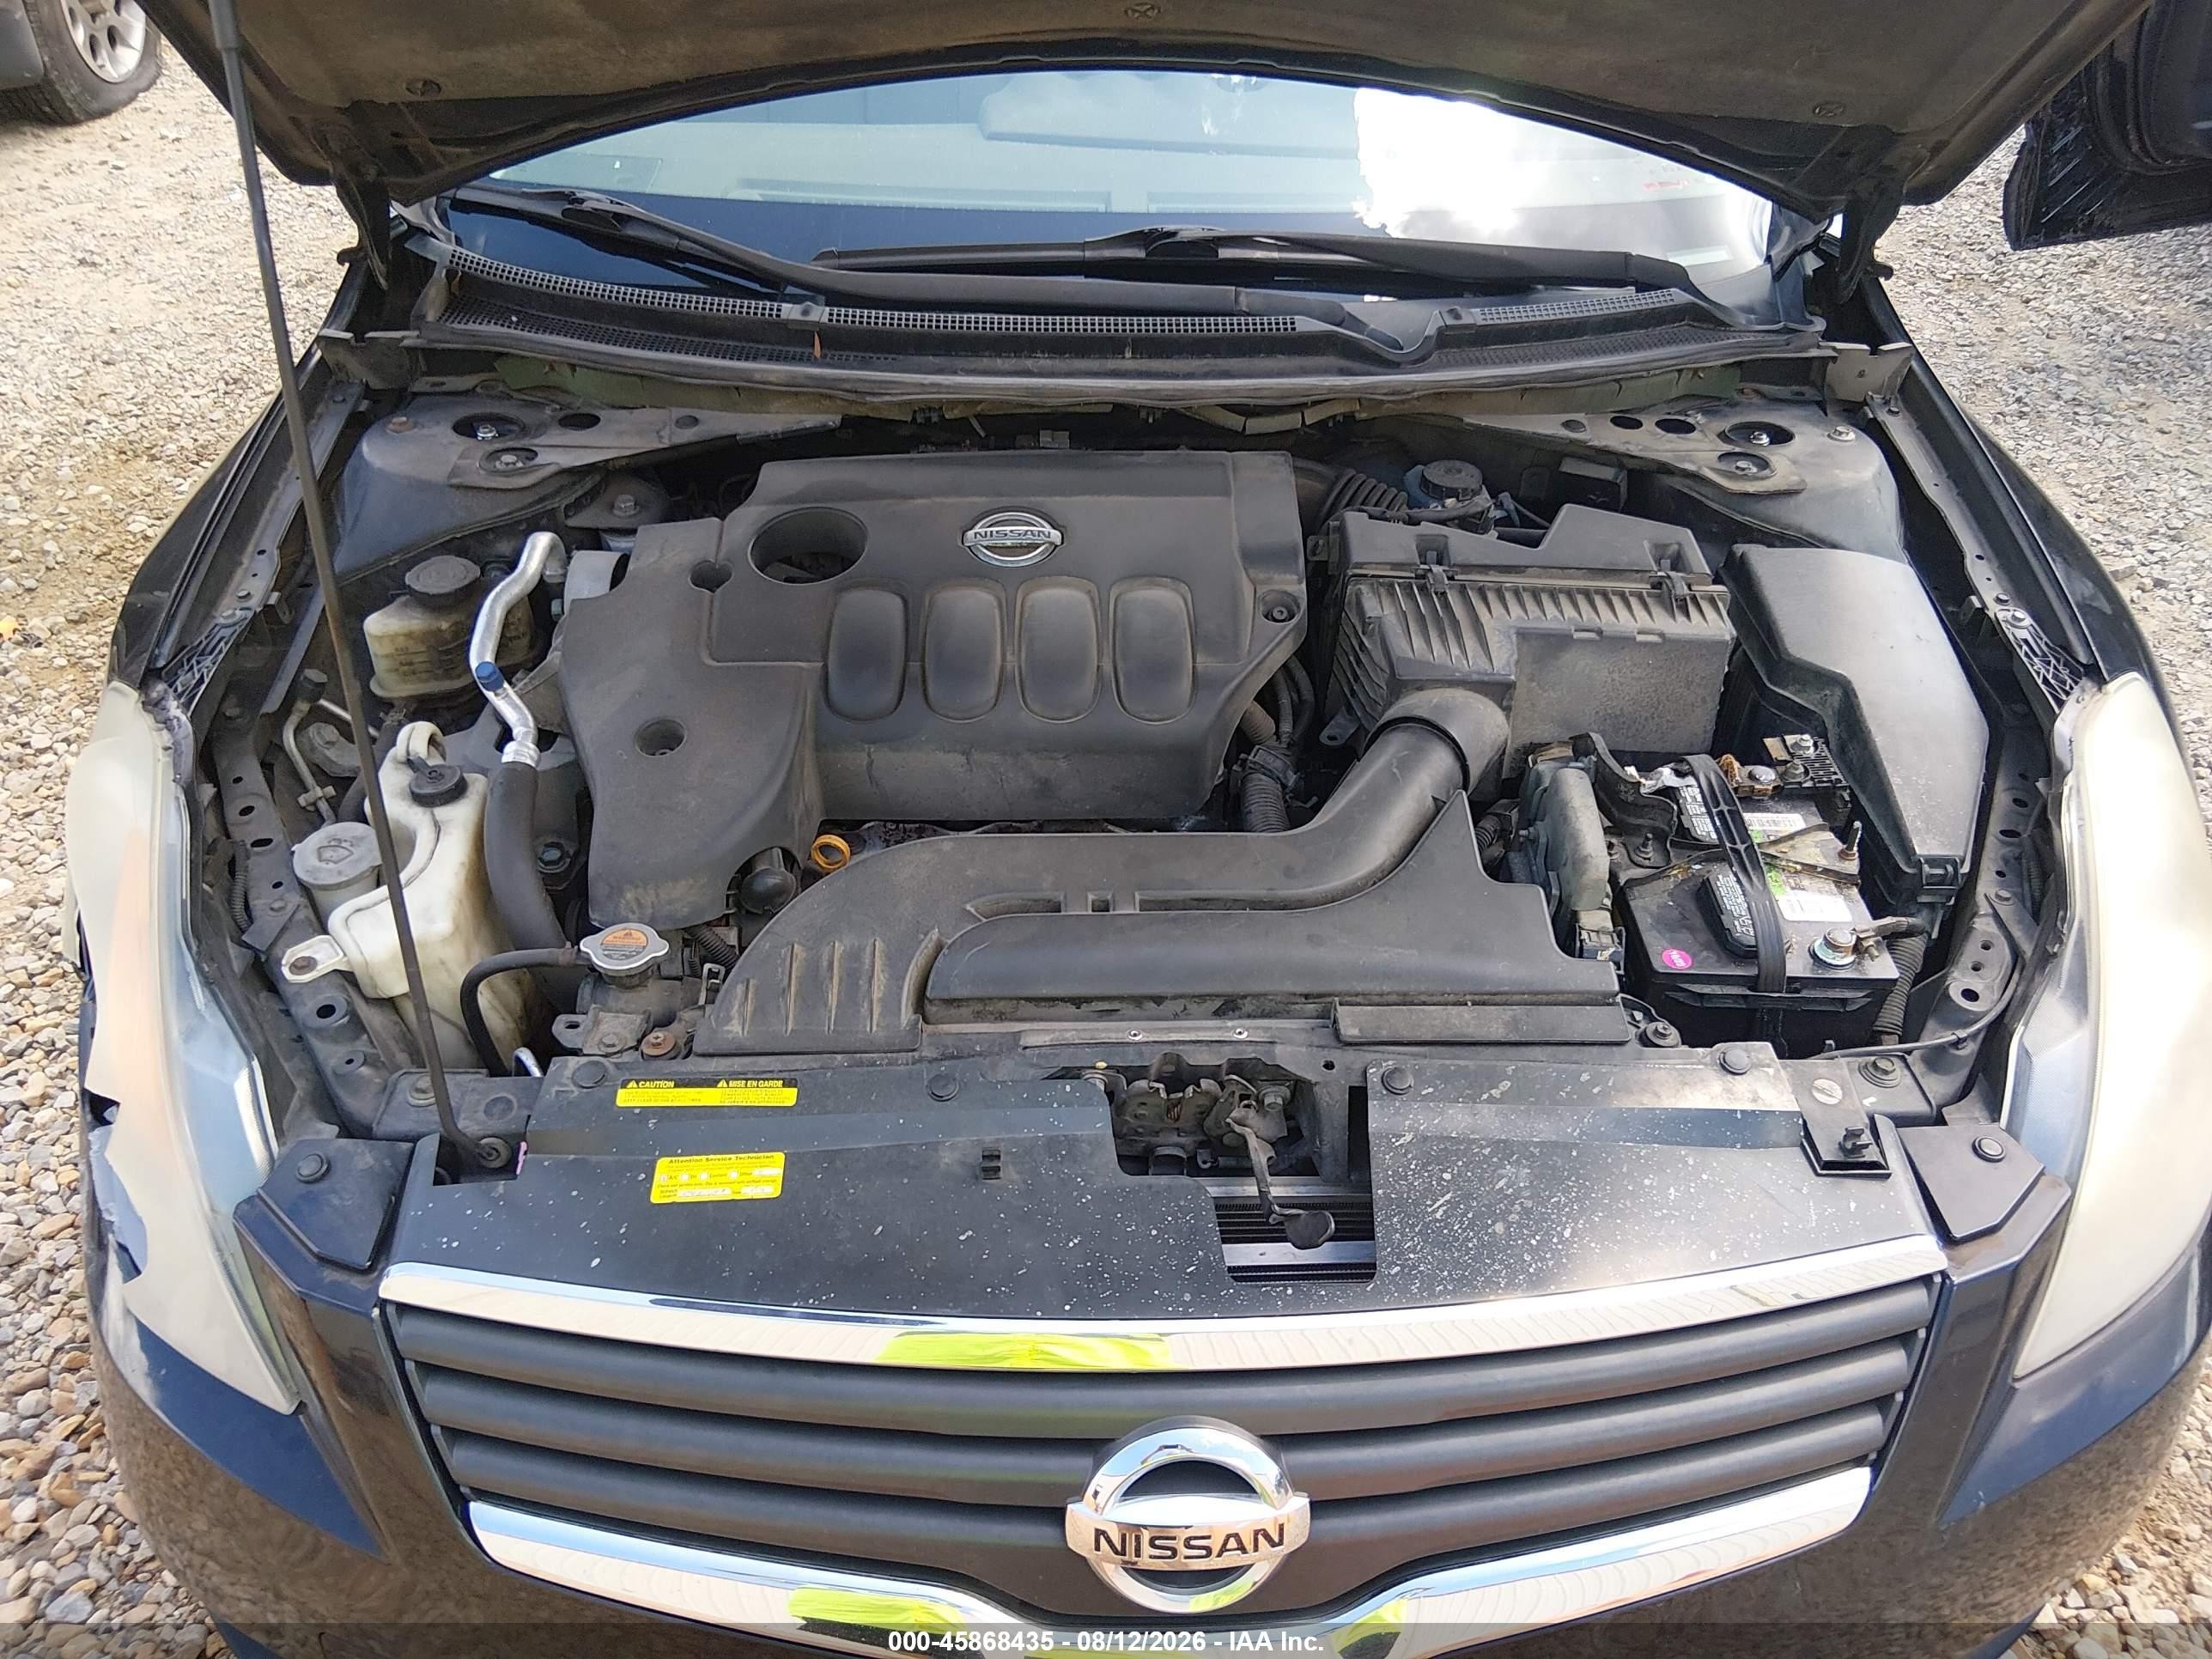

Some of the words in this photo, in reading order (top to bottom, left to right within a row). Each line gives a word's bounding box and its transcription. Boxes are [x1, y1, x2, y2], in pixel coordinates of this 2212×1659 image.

[974, 529, 1051, 539] NISSAN
[728, 1079, 746, 1088] MISE
[746, 1079, 757, 1088] EN
[758, 1079, 783, 1088] GARDE
[1093, 1522, 1285, 1561] NISSAN
